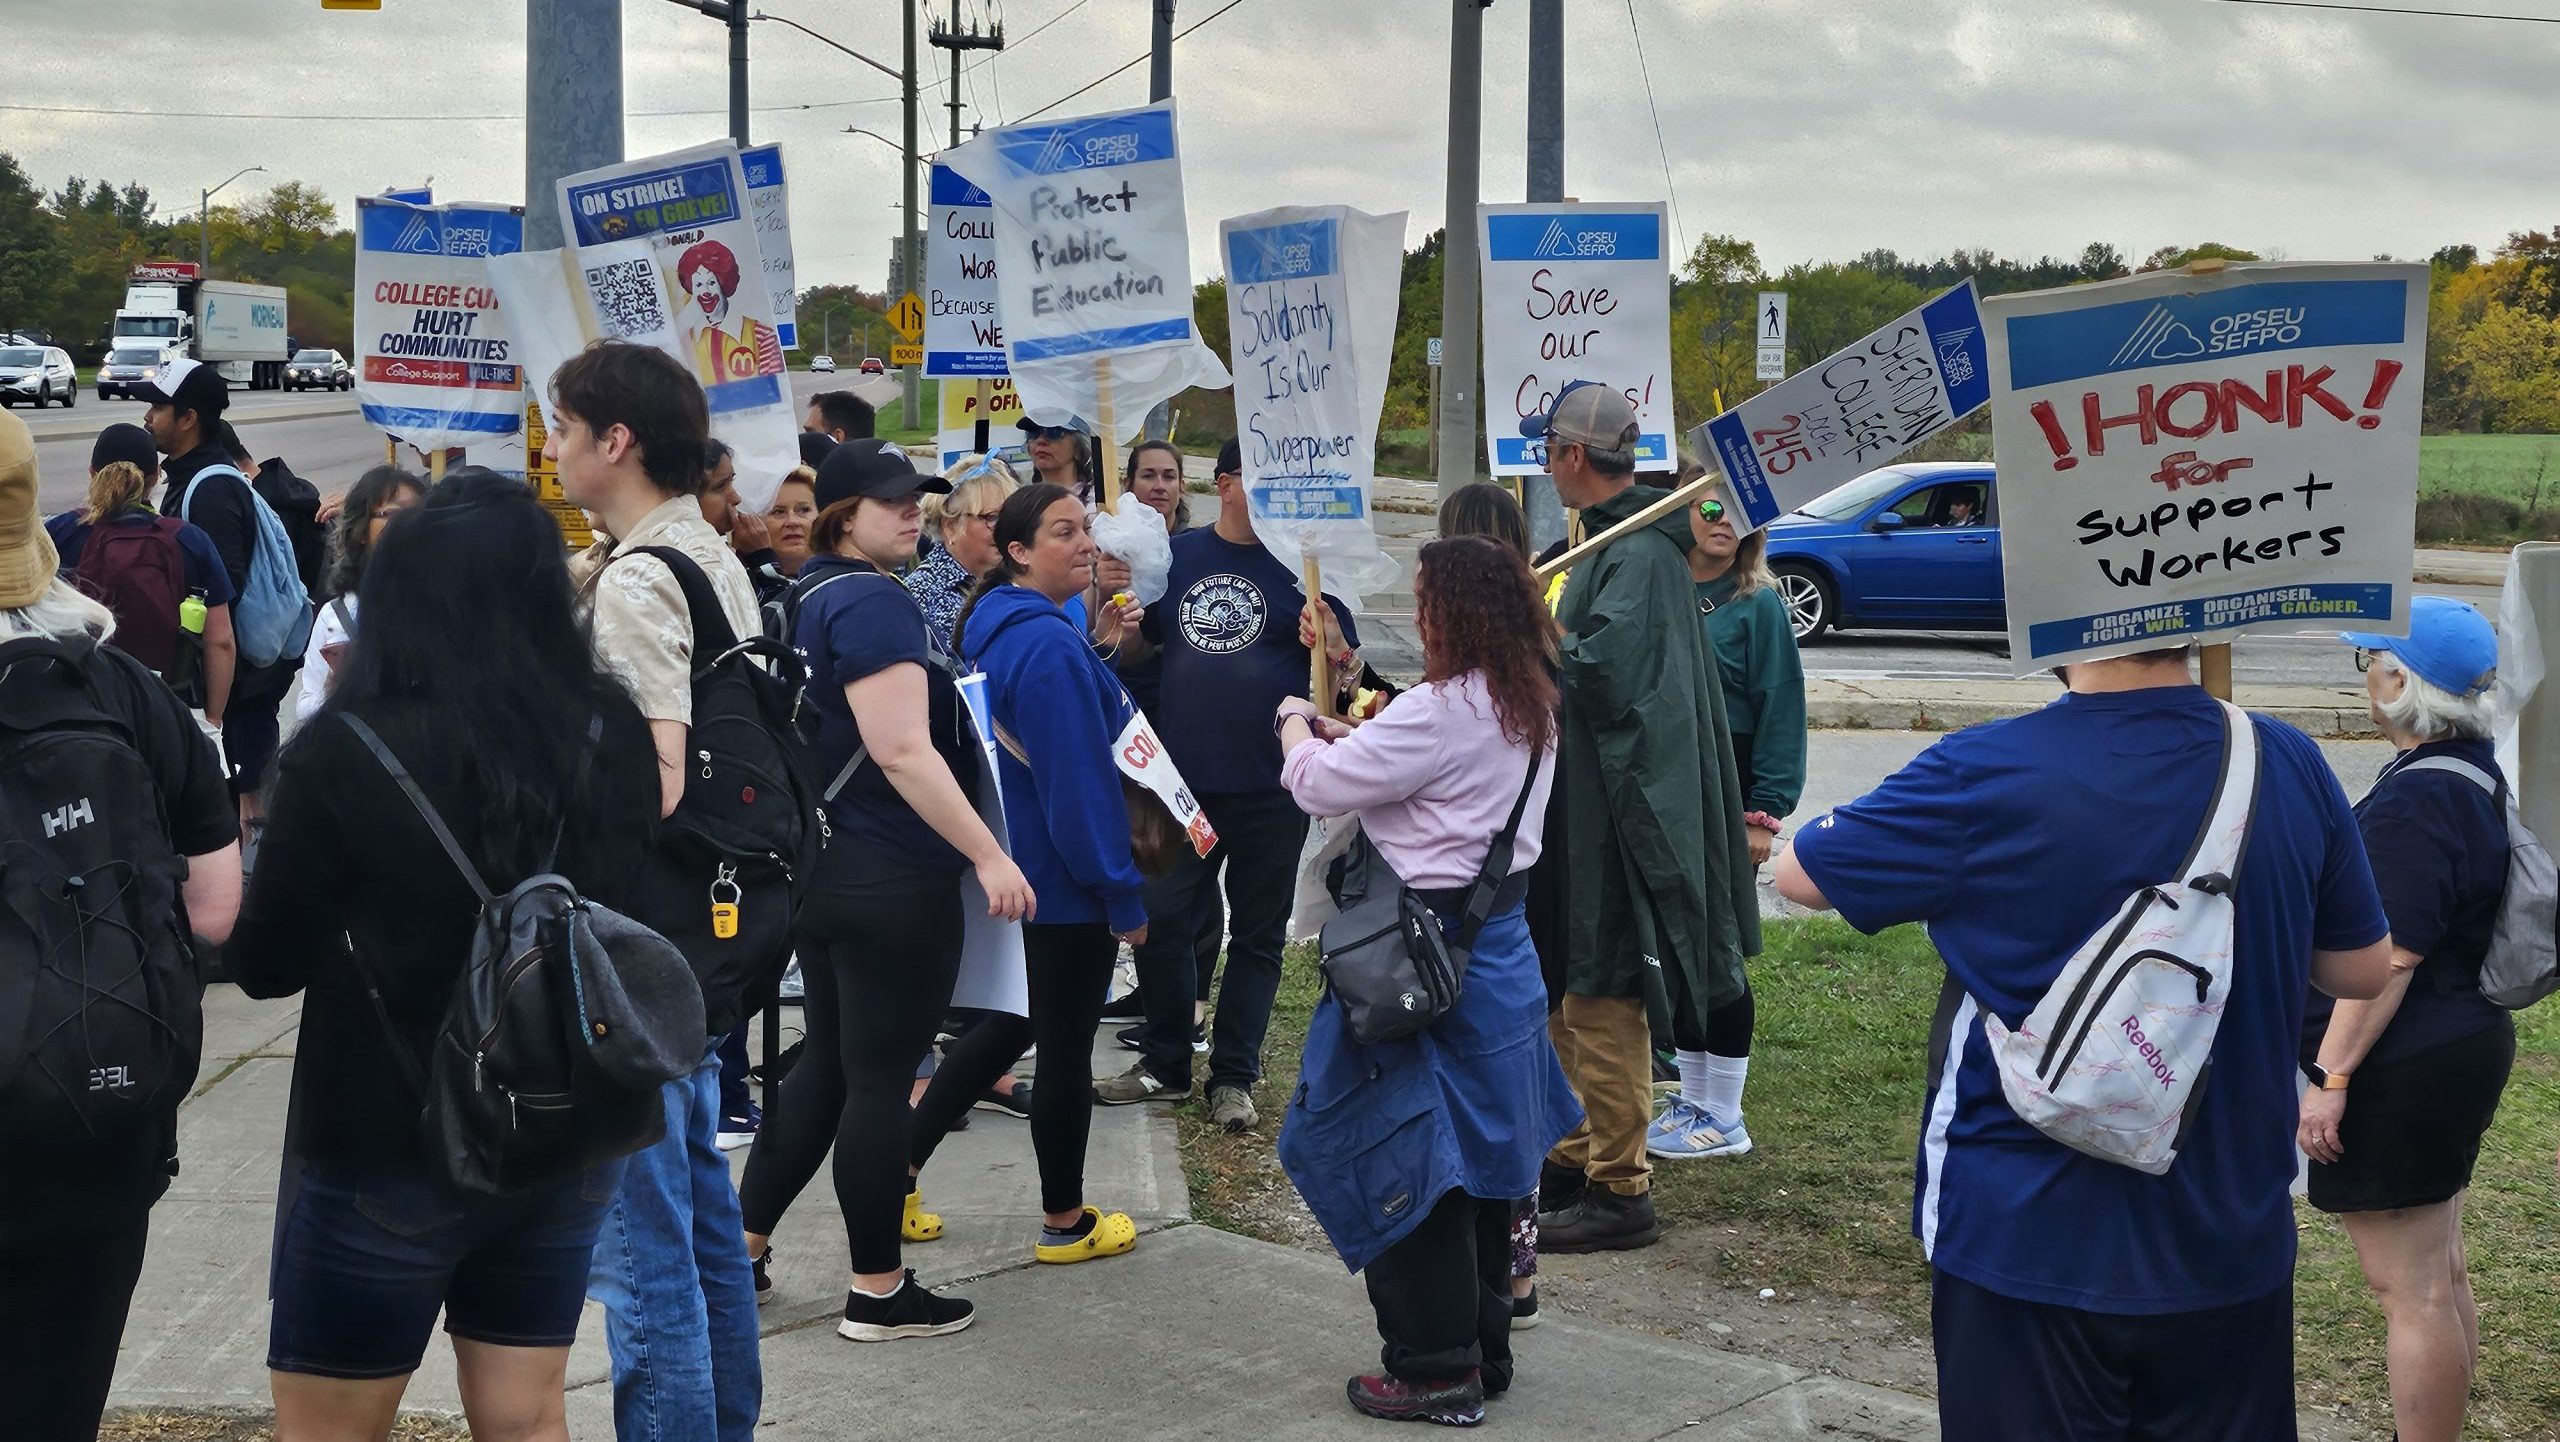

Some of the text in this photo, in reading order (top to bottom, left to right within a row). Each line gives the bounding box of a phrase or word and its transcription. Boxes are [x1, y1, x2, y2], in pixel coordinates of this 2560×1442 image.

[1085, 133, 1139, 151] OPSEU
[1086, 147, 1138, 166] SEFPO
[581, 175, 686, 216] ON STRIKE!
[1030, 180, 1138, 222] Protect
[445, 227, 491, 242] OPSEU
[946, 211, 994, 240] COLL
[1577, 231, 1618, 244] OPSEU
[1032, 230, 1127, 273] Public
[1283, 243, 1312, 258] OPSEU
[1577, 244, 1616, 256] SEFPO
[375, 281, 460, 308] COLLEGE
[931, 289, 996, 317] BECAUSE
[1032, 270, 1164, 317] Education
[1527, 269, 1618, 321] Save
[412, 308, 478, 337] HURT
[971, 319, 1005, 349] WE
[1240, 282, 1334, 357] Solidarity
[2208, 306, 2306, 336] OPSEU
[379, 333, 510, 362] COMMUNITIES
[896, 349, 915, 359] 100
[1540, 330, 1600, 361] our
[2208, 325, 2302, 354] SEFPO
[386, 363, 460, 382] College Support
[1260, 347, 1333, 403] Is Our
[1956, 352, 1975, 381] OPSEU
[1871, 326, 1949, 446] SHERIDAN
[1821, 356, 1897, 464] COLLEGE
[1250, 412, 1355, 475] Superpower
[1752, 414, 1813, 476] 245
[1800, 404, 1839, 458] LOCAL
[2150, 451, 2254, 492] for
[2097, 525, 2346, 588] Workers
[1205, 576, 1233, 588] FUTURE
[2082, 599, 2365, 645] FIGHT. WIN. LUTTER. GAGNER.
[2091, 586, 2318, 631] ORGANIZE. ORGANISER.
[1207, 641, 1225, 651] PEUT
[1225, 638, 1244, 651] PLUS
[41, 797, 95, 838] HH
[2120, 1014, 2178, 1092] Reebok
